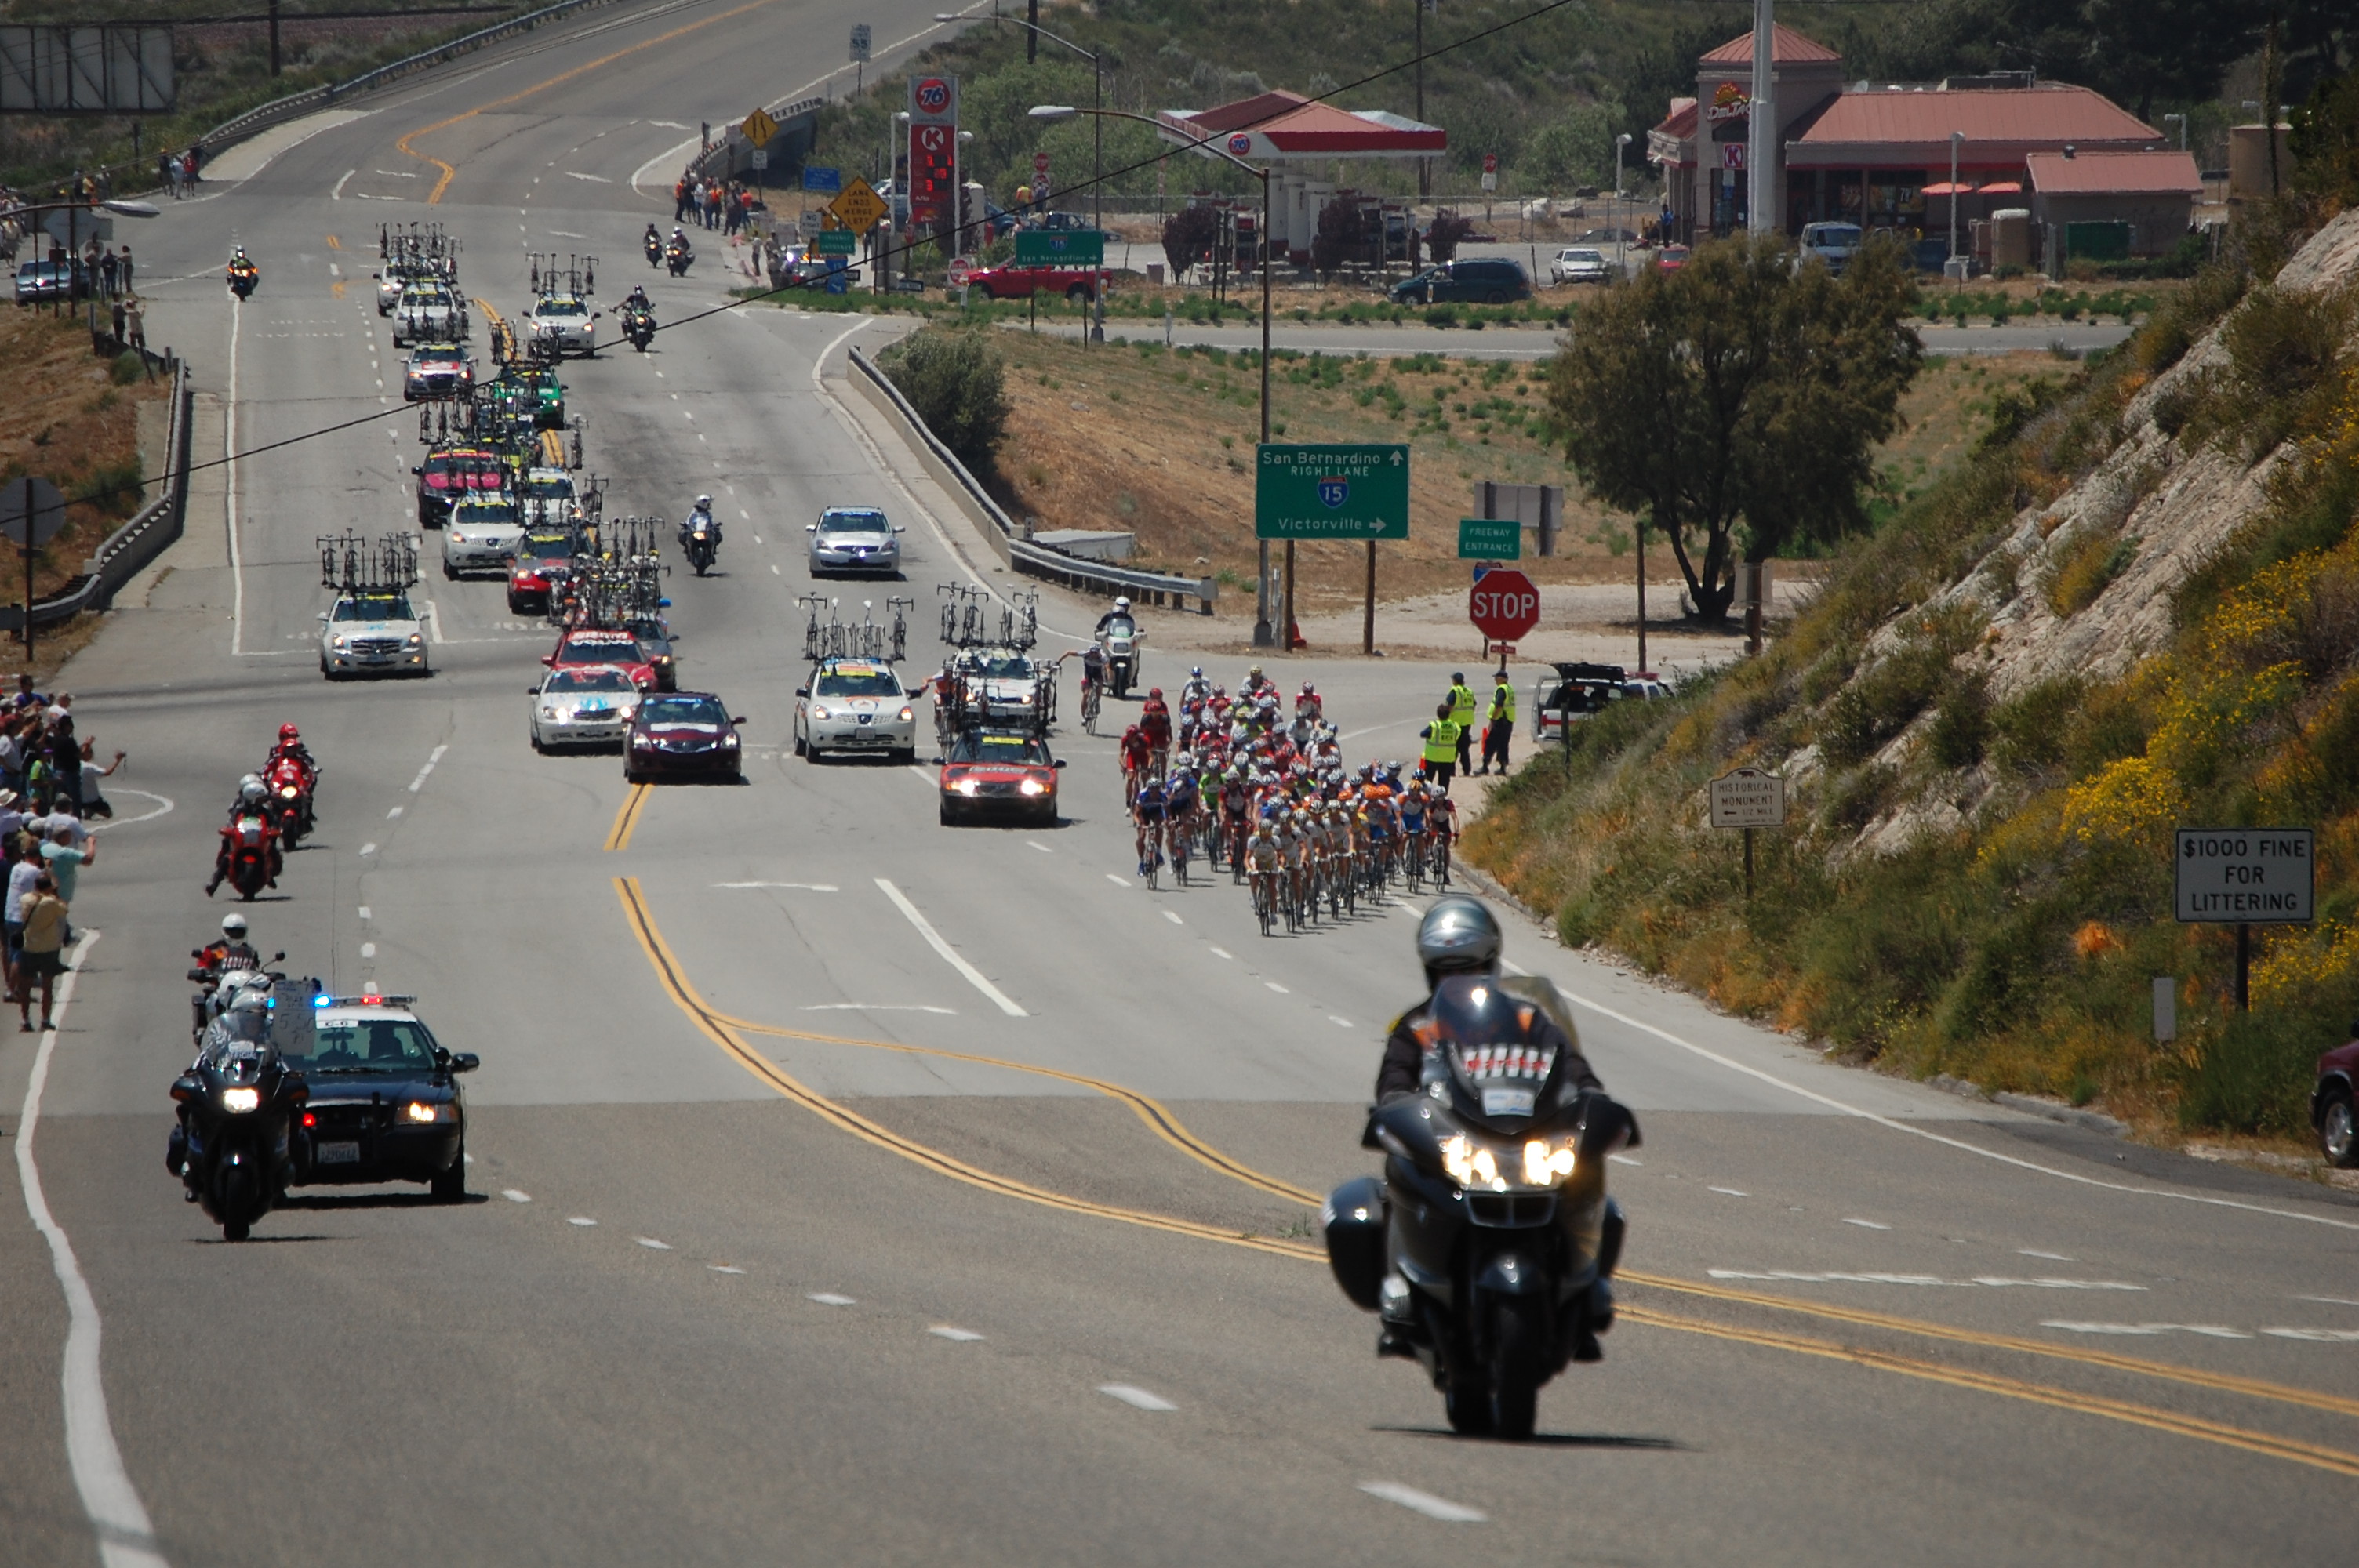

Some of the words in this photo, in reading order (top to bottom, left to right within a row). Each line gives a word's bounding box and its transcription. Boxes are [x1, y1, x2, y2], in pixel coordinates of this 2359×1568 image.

[921, 87, 945, 105] 76
[925, 129, 943, 147] K
[1233, 139, 1247, 151] 76
[1728, 147, 1739, 164] K
[1263, 452, 1291, 464] San
[1298, 452, 1380, 464] Bernardino
[1291, 466, 1330, 477] RIGHT
[1337, 466, 1369, 477] LANE
[1325, 486, 1343, 502] 15
[1278, 517, 1362, 530] Victorville
[1469, 528, 1510, 537] FREEWAY
[1465, 542, 1514, 553] ENTRANCE
[1474, 592, 1535, 619] STOP
[1718, 782, 1775, 793] HISTORICAL
[1721, 795, 1774, 806] MONUMENT
[2184, 838, 2248, 858] $1000
[2259, 840, 2306, 857] FINE
[2225, 866, 2265, 884] FOR
[2192, 893, 2297, 911] LITTERING
